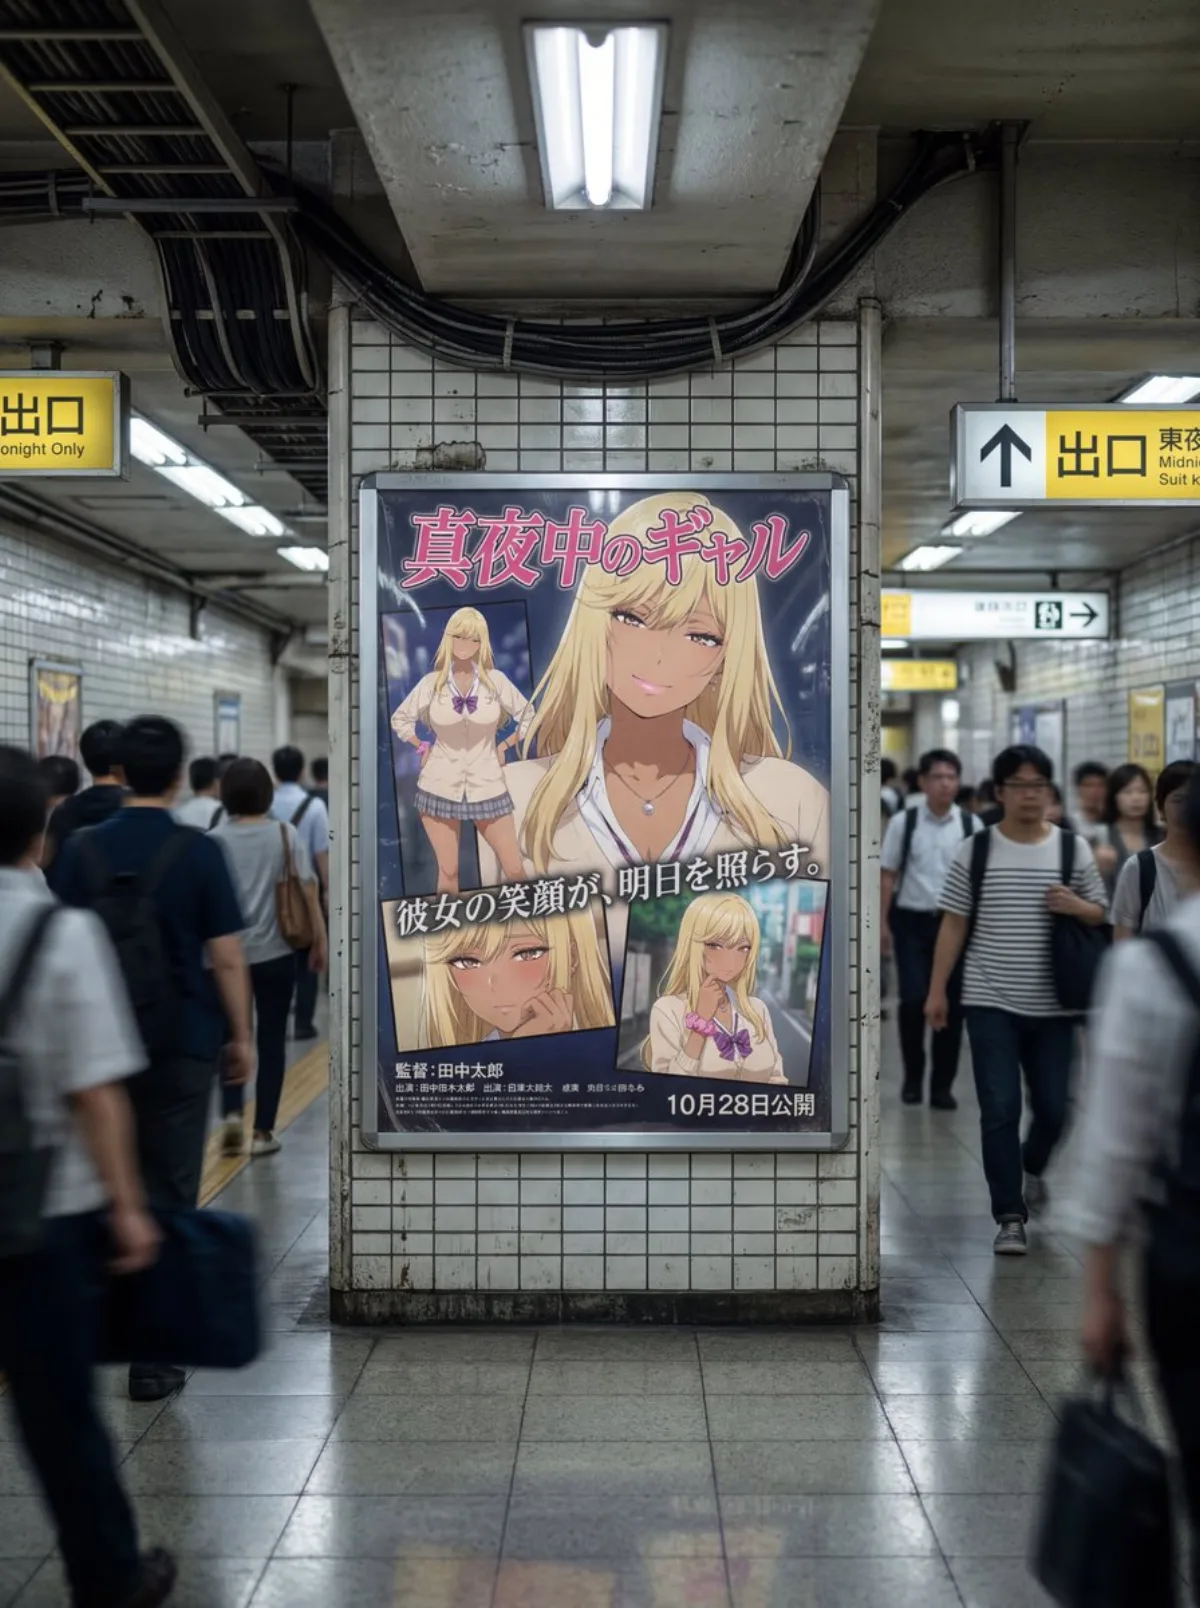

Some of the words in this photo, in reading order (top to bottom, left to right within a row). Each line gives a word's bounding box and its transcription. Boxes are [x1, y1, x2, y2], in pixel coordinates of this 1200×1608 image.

[1, 393, 83, 436] 出口
[51, 442, 85, 458] Only
[1058, 431, 1146, 478] 出口
[1159, 456, 1200, 468] Midni
[1159, 473, 1187, 485] Suit
[401, 505, 810, 588] 真夜中のギャル
[397, 843, 819, 937] 彼女の笑顔が、明日を照らす。
[395, 1062, 504, 1079] 監督：田中太郎
[667, 1093, 815, 1117] 10月28日公開
